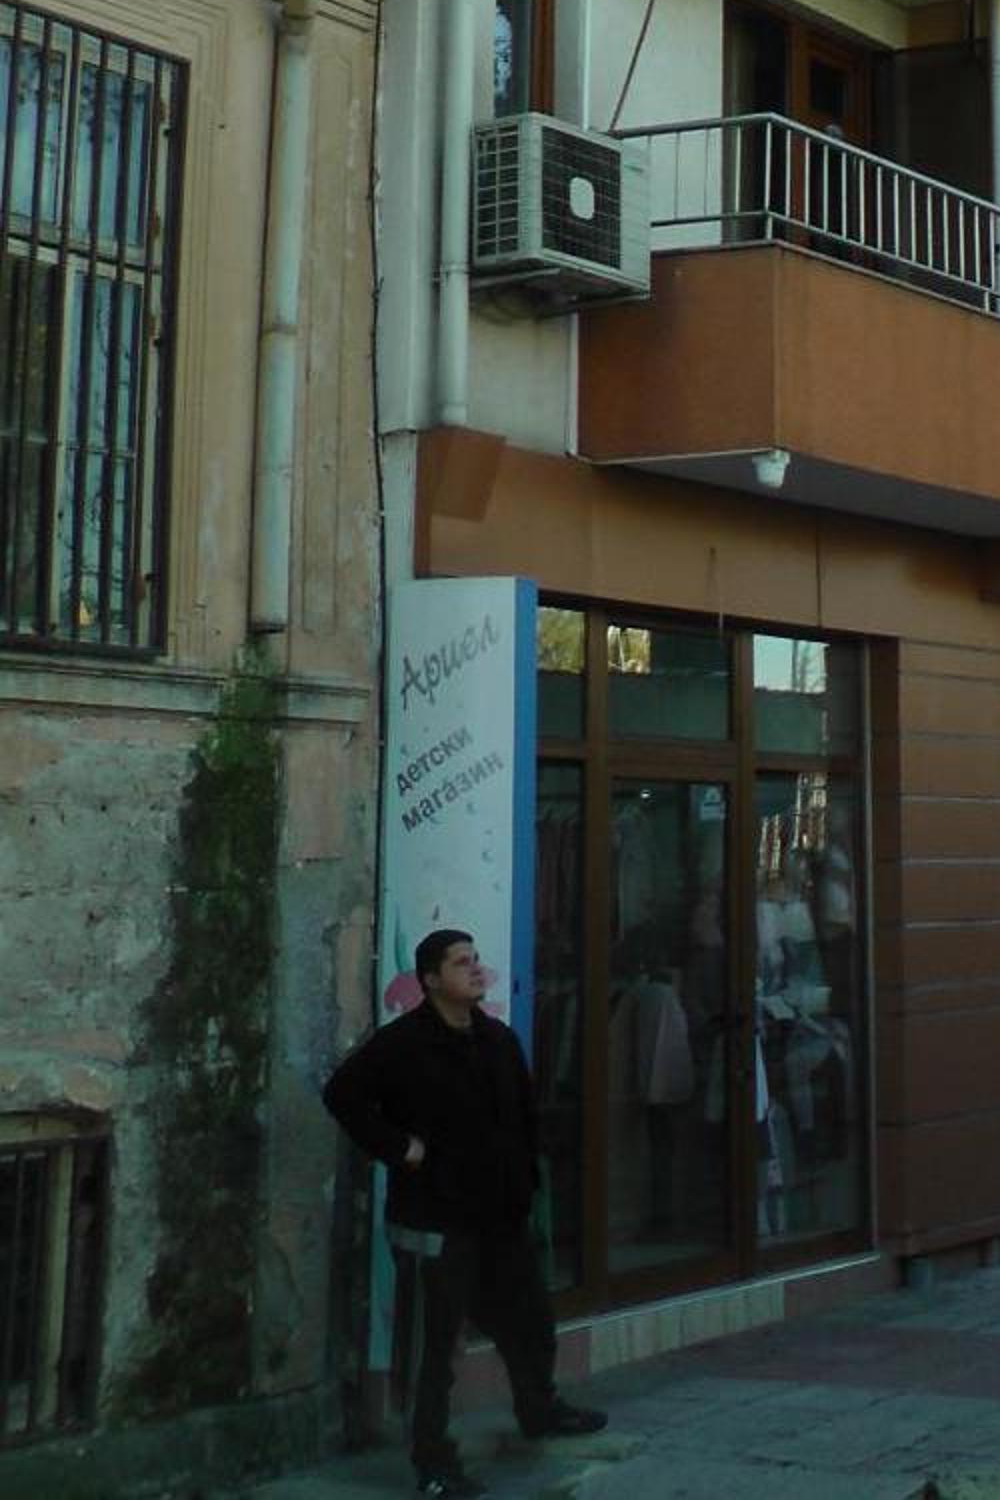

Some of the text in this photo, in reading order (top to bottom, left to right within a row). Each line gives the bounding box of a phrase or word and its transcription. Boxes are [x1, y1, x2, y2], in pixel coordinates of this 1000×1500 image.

[401, 613, 498, 711] Ариел
[396, 726, 473, 797] детски
[401, 752, 503, 833] магазин
